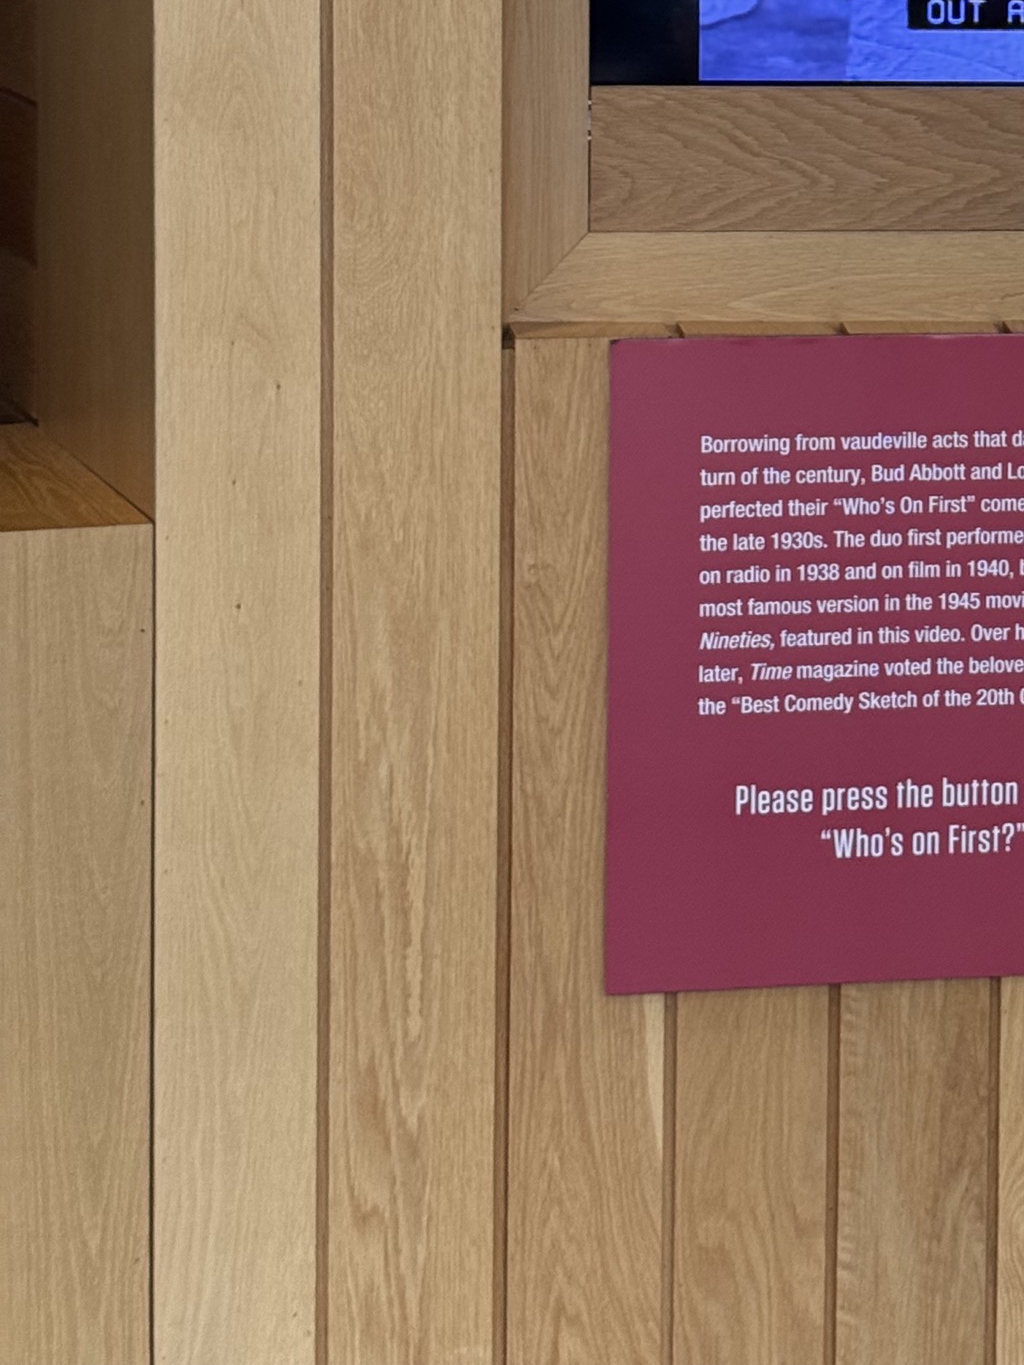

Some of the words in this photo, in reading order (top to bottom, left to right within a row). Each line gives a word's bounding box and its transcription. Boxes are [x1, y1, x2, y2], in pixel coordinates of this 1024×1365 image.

[926, 0, 985, 24] OUT
[700, 433, 791, 456] Borrowing
[794, 433, 836, 452] from
[840, 431, 928, 451] vaudeville
[931, 430, 969, 449] acts
[972, 430, 1008, 448] that
[699, 468, 736, 487] turn
[740, 466, 759, 486] of
[761, 466, 791, 485] the
[795, 465, 866, 487] century,
[871, 463, 905, 483] Bud
[908, 463, 967, 482] Abbott
[970, 462, 1003, 481] and
[699, 499, 784, 524] perfected
[787, 498, 829, 517] their
[899, 495, 924, 515] On
[698, 533, 728, 552] the
[732, 532, 766, 552] late
[770, 531, 828, 550] 1930s.
[832, 529, 866, 548] The
[869, 529, 903, 548] duo
[906, 528, 942, 547] first
[698, 569, 722, 586] on
[725, 564, 771, 584] radio
[775, 564, 792, 583] in
[796, 562, 841, 582] 1938
[844, 561, 877, 581] and
[881, 564, 904, 580] on
[907, 560, 941, 579] film
[945, 559, 962, 578] in
[967, 559, 1015, 579] 1940,
[699, 598, 744, 618] most
[746, 597, 813, 616] famous
[816, 594, 880, 614] version
[884, 593, 901, 612] in
[904, 593, 934, 611] the
[938, 591, 981, 611] 1945
[699, 630, 776, 651] Nineties,
[779, 627, 853, 648] featured
[857, 627, 874, 645] in
[877, 625, 911, 645] this
[914, 625, 966, 644] video.
[970, 623, 1011, 643] Over
[698, 664, 744, 685] later,
[750, 662, 794, 681] Time
[796, 659, 880, 683] magazine
[883, 657, 932, 677] voted
[935, 657, 965, 675] the
[697, 697, 727, 716] the
[783, 692, 855, 714] Comedy
[858, 690, 918, 710] Sketch
[921, 689, 941, 708] of
[943, 689, 972, 708] the
[975, 687, 1015, 706] 20th
[735, 784, 814, 816] Please
[821, 785, 888, 816] press
[896, 778, 934, 809] the
[941, 776, 1019, 808] button
[911, 831, 940, 856] on
